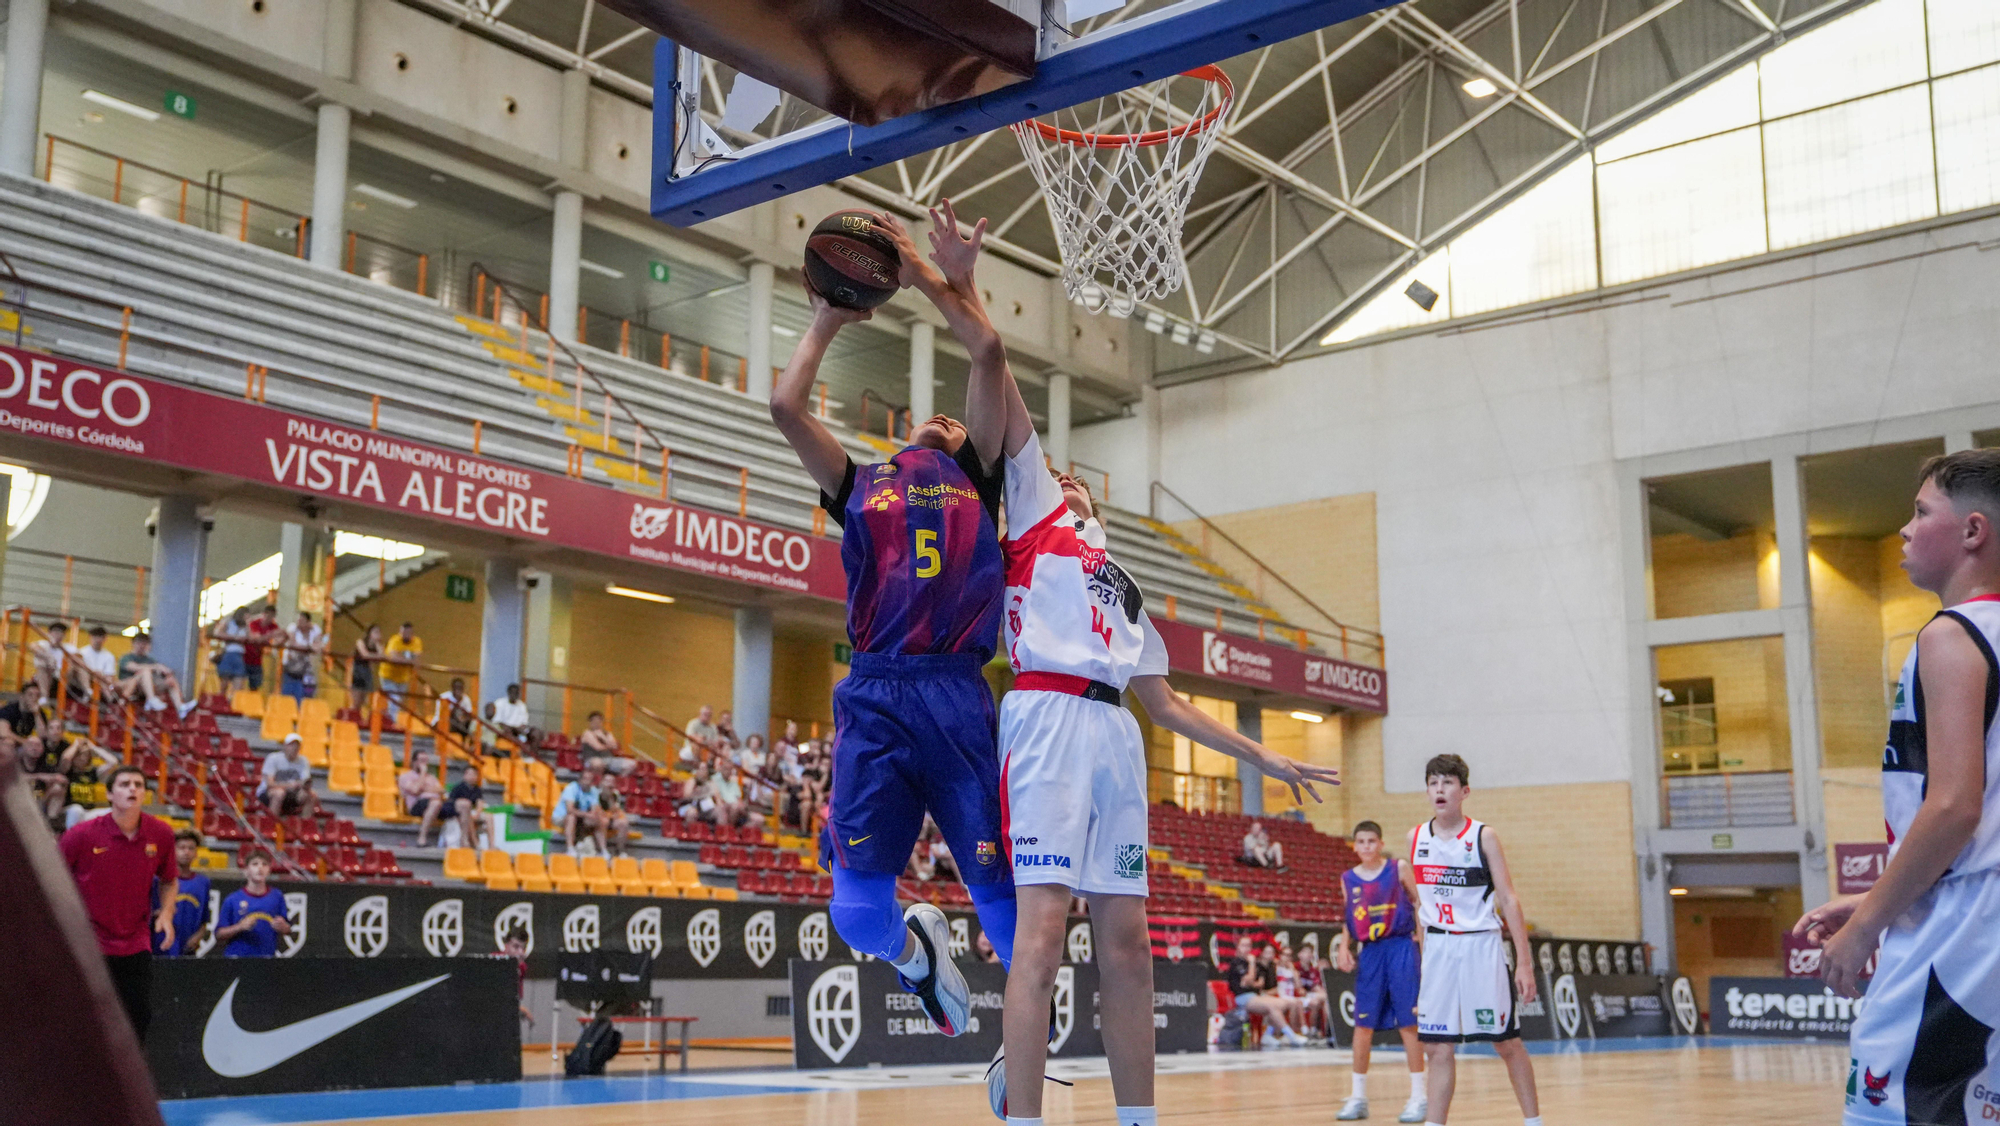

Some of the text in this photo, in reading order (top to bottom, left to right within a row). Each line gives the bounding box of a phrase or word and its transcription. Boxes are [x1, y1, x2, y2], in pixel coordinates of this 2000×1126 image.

[831, 242, 893, 277] REACTION
[872, 273, 888, 283] PRO
[0, 409, 145, 453] Deportes Córdoba
[287, 419, 531, 491] PALACIO MUNICIPAL DEPORTES
[265, 438, 550, 535] VISTA ALEGRE
[907, 483, 980, 500] Assistència
[908, 494, 959, 510] Sanitària
[675, 510, 811, 572] IMDECO
[915, 529, 941, 578] 5
[453, 579, 468, 599] H
[1088, 577, 1118, 607] 2031
[1322, 662, 1381, 695] IMDECO
[1015, 836, 1038, 846] vive
[1015, 853, 1071, 868] PULEVA
[1433, 887, 1453, 897] 2031
[1436, 903, 1454, 924] 19
[1728, 1017, 1794, 1031] despierta
